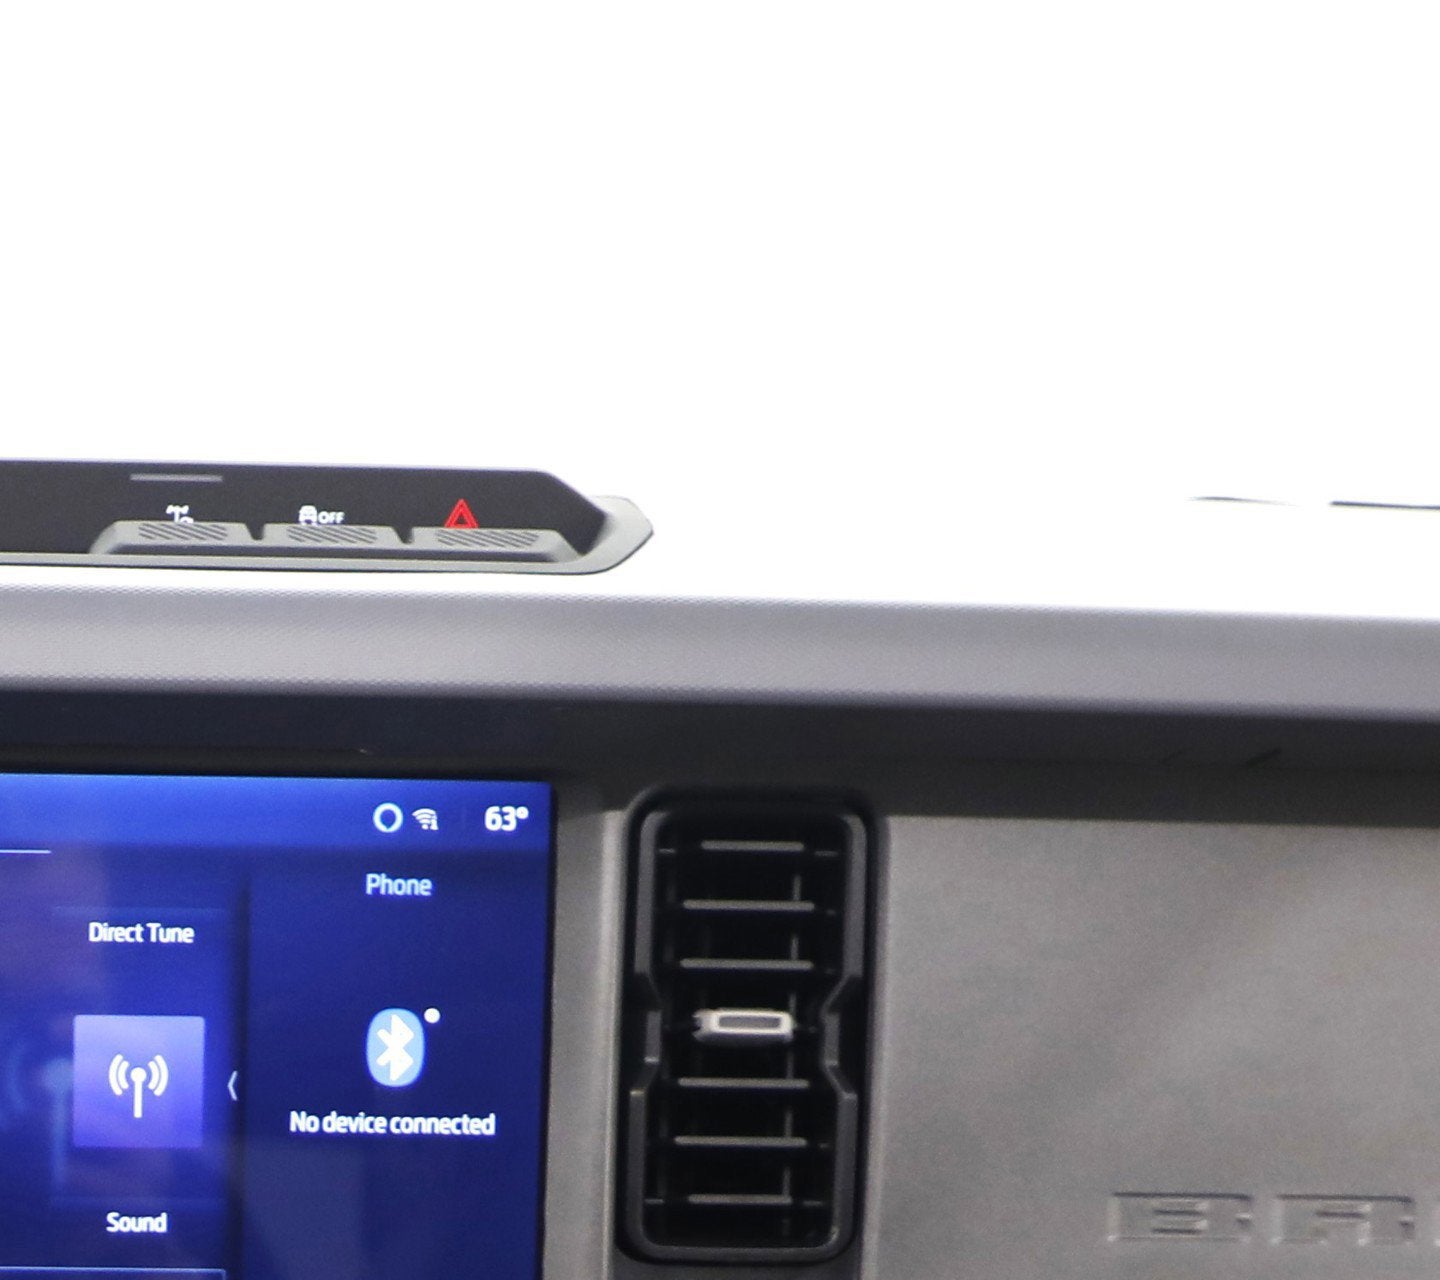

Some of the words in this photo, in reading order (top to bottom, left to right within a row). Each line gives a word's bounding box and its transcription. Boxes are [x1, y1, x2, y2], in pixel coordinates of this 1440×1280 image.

[318, 510, 346, 524] OFF
[364, 872, 433, 897] Phone
[88, 921, 145, 945] Direct
[145, 922, 196, 945] Tune
[289, 1110, 321, 1135] No
[320, 1110, 389, 1137] device
[389, 1112, 497, 1137] connected
[106, 1211, 169, 1234] Sound
